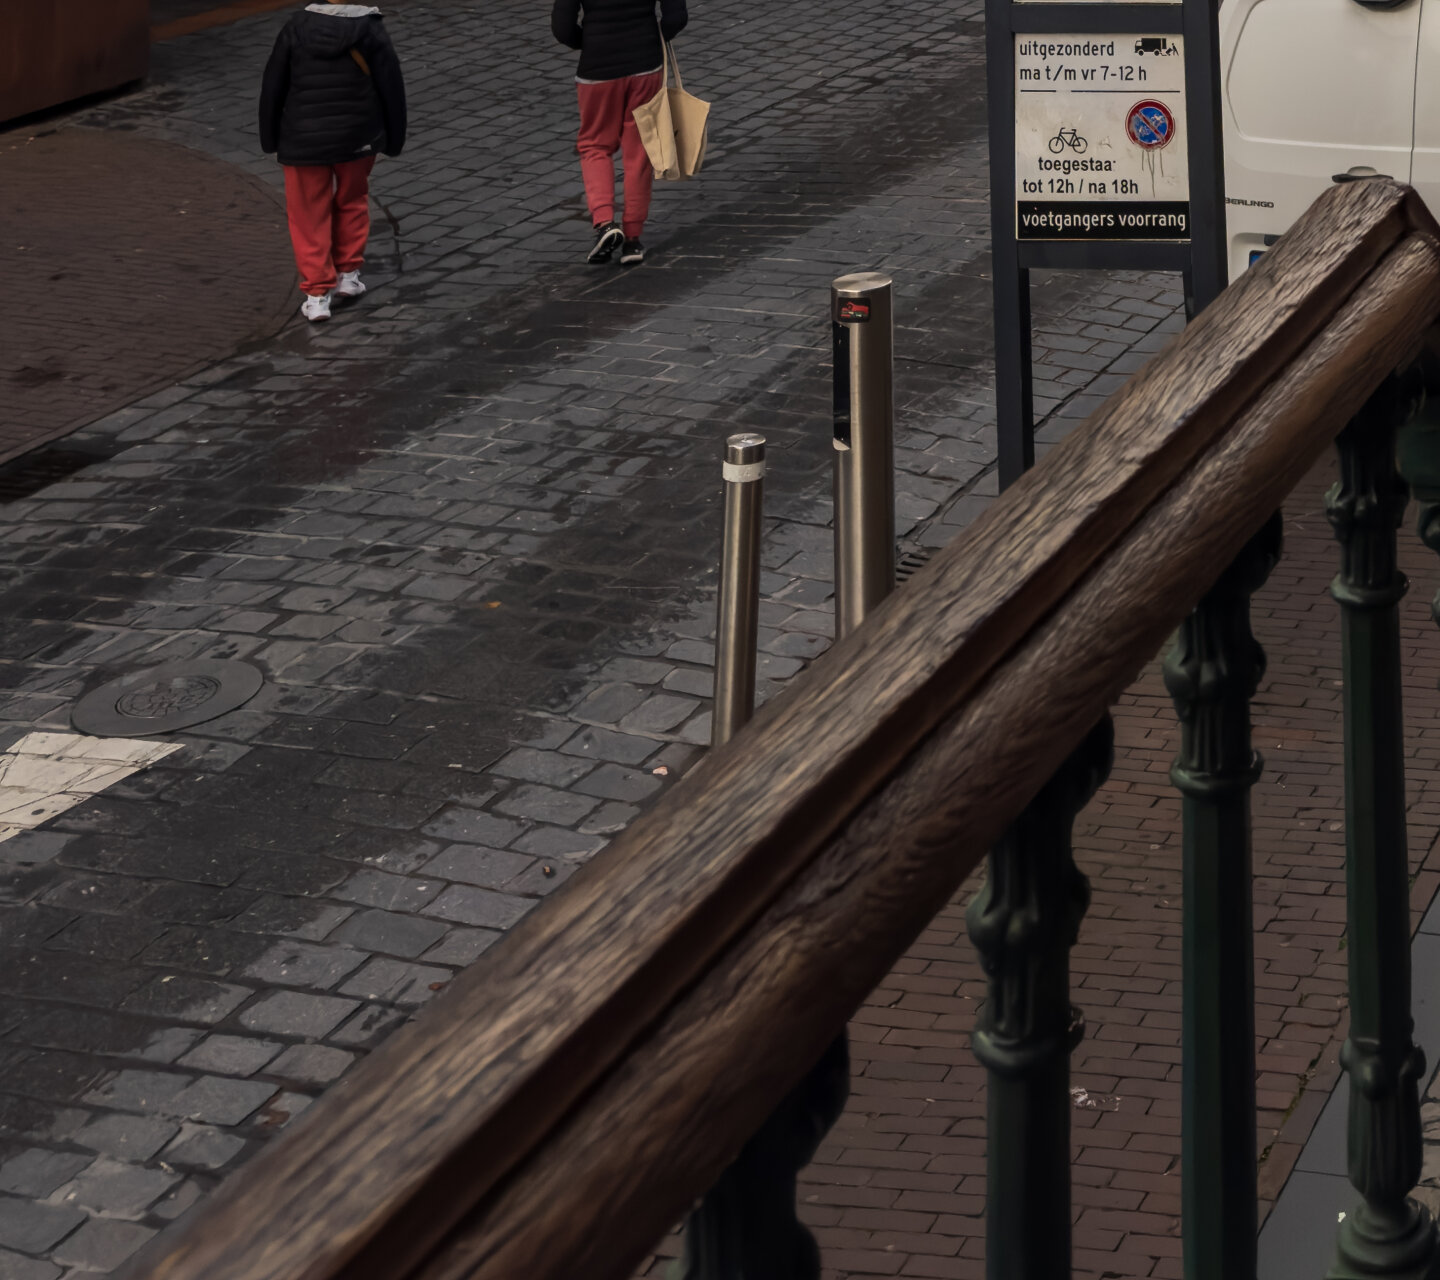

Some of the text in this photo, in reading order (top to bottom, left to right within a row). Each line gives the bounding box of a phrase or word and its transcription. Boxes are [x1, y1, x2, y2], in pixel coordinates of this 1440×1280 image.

[1019, 41, 1114, 60] uitgezonderd
[1019, 65, 1147, 81] ma t/m vr 7-12 h
[1038, 157, 1116, 175] toegestaa
[1023, 179, 1043, 193] tot
[1048, 179, 1074, 194] 12h
[1088, 181, 1106, 194] na
[1112, 179, 1139, 194] 18h
[1225, 197, 1274, 208] BERLINGO
[1022, 211, 1186, 231] voetgangers voorrang
